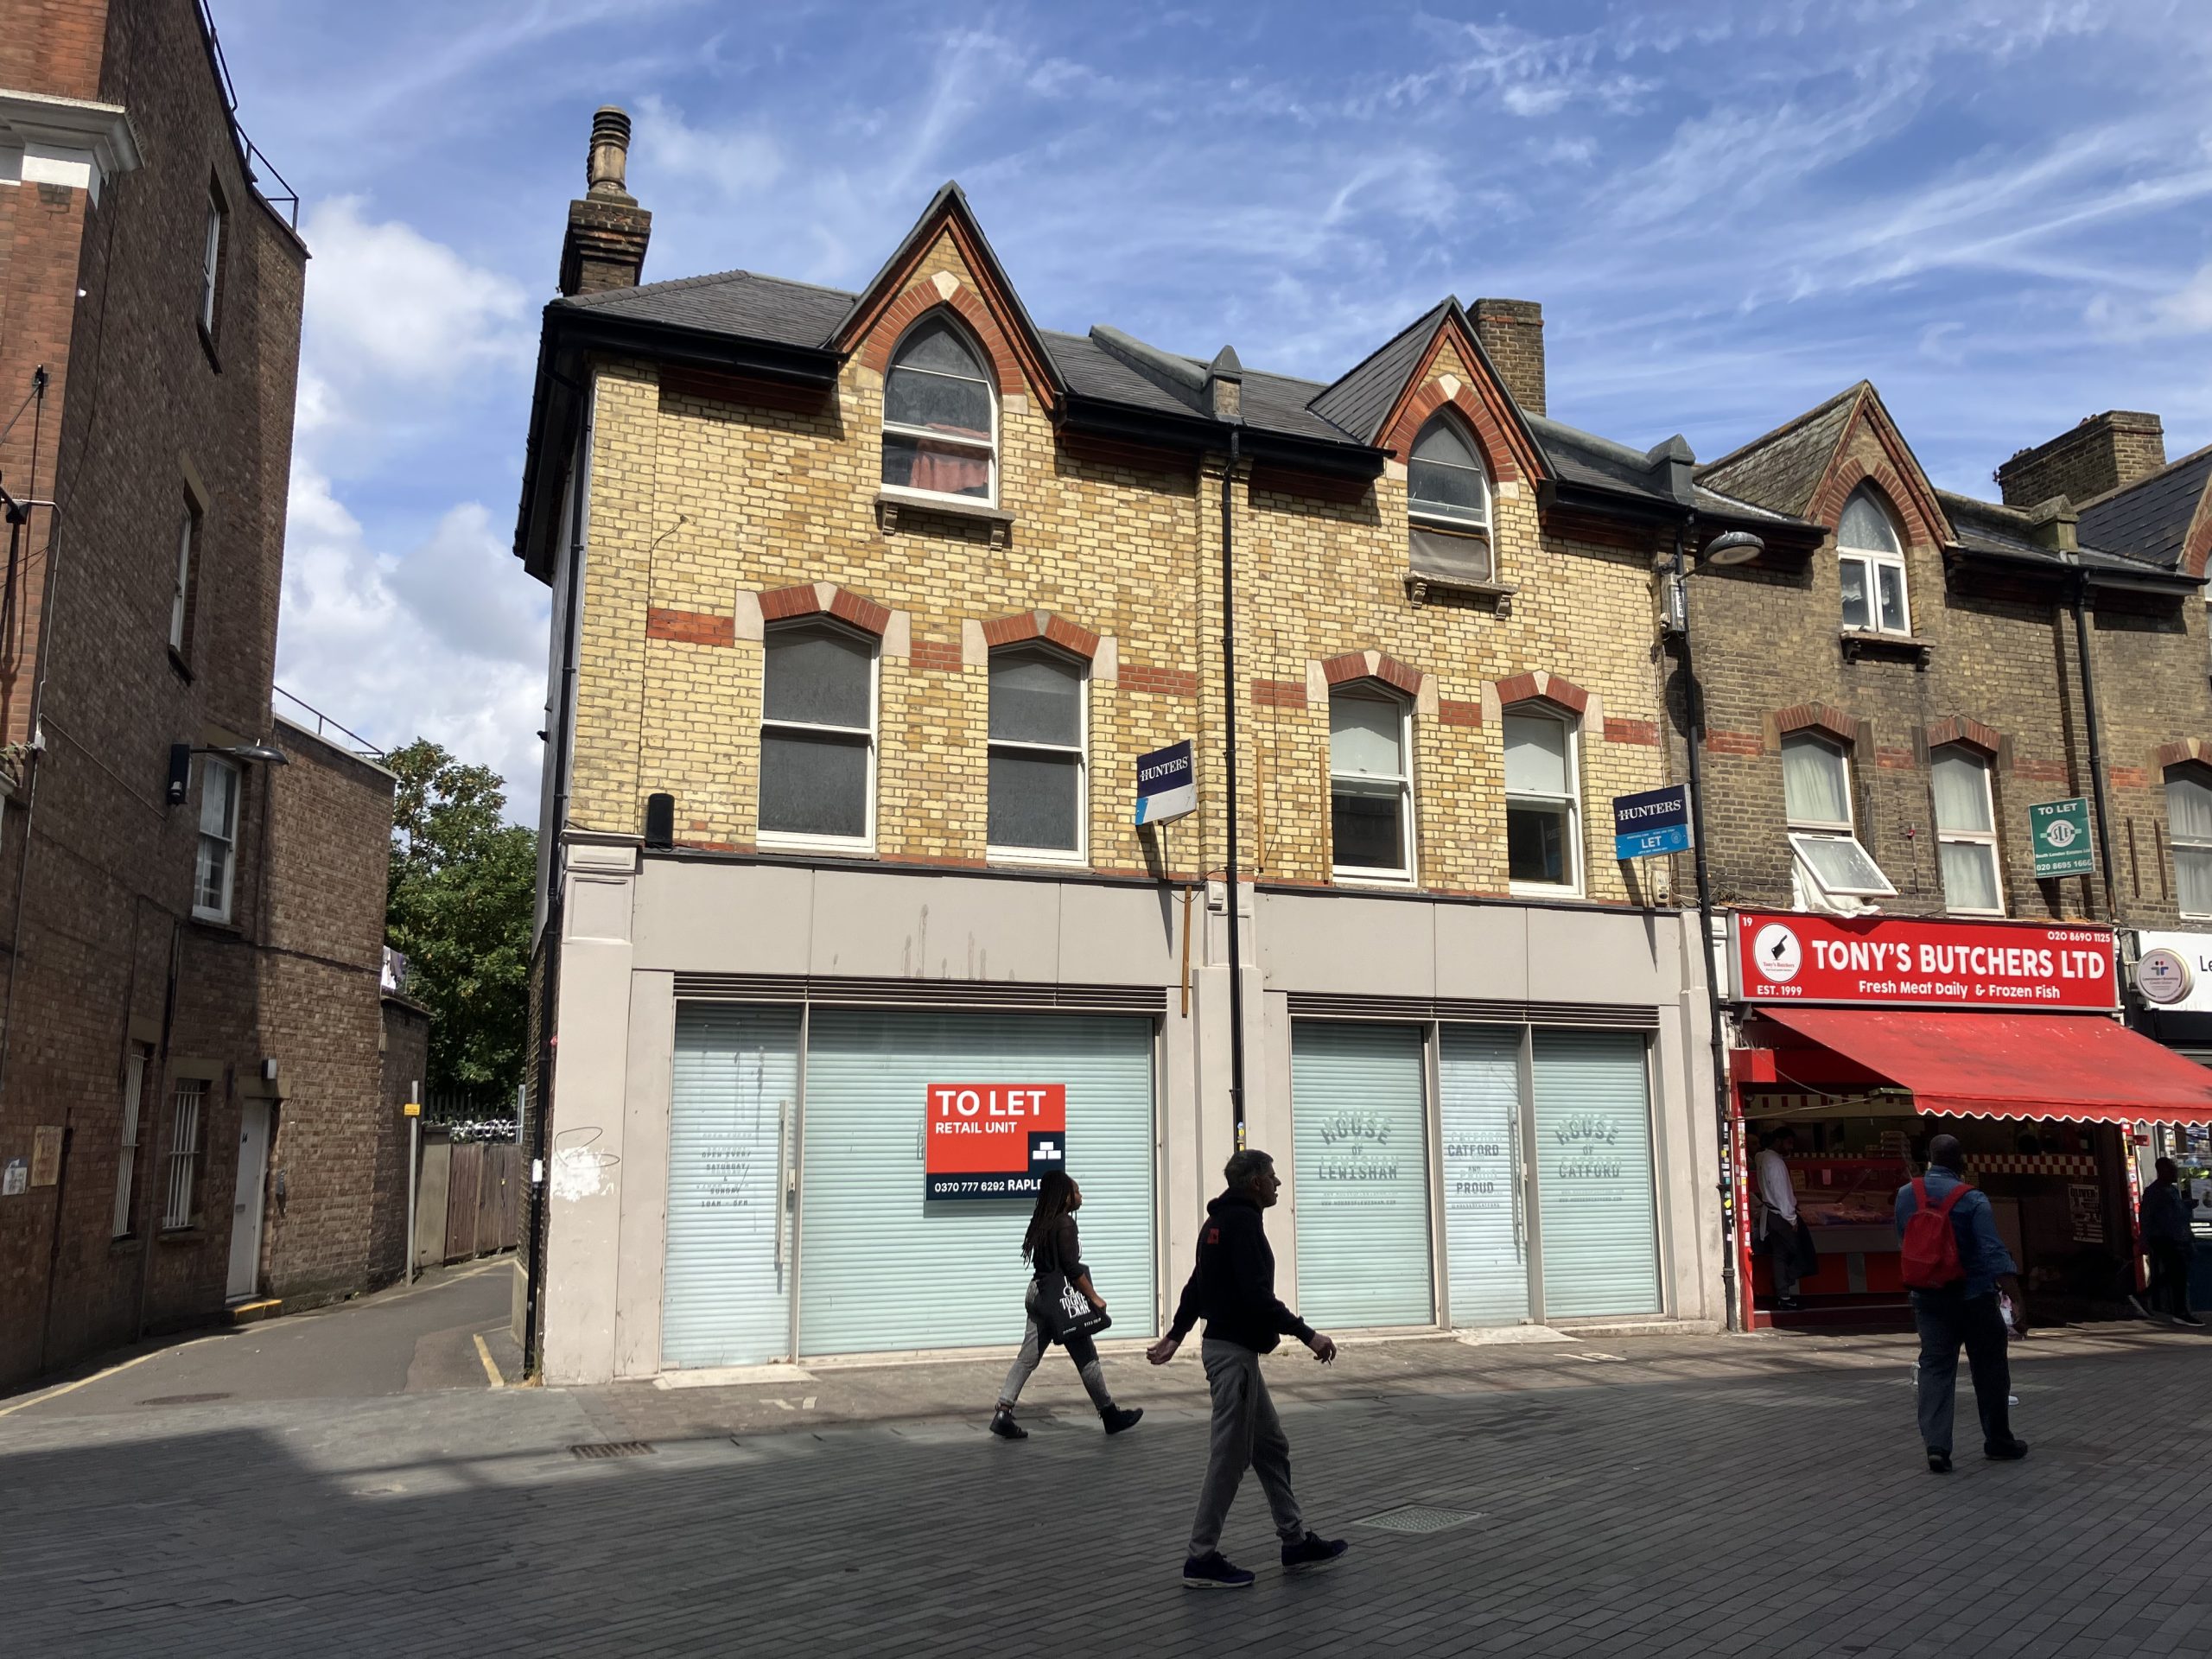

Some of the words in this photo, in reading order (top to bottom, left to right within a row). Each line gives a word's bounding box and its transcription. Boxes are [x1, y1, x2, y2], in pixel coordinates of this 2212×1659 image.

[1140, 756, 1188, 782] HUNTERS
[1618, 799, 1681, 821] HUNTERS
[2037, 806, 2054, 816] TO
[2056, 803, 2078, 813] LET
[1642, 836, 1662, 849] LET
[2052, 861, 2072, 870] 8695
[1742, 917, 1753, 927] 19
[2048, 931, 2068, 941] 020
[2069, 931, 2092, 942] 8690
[2094, 932, 2111, 943] 1125
[1811, 939, 1912, 973] TONY'S
[1919, 944, 2054, 978] BUTCHERS
[2061, 950, 2106, 979] LTD
[1757, 985, 1779, 995] EST.
[1781, 986, 1802, 996] 1999
[1859, 980, 1897, 994] Fresh
[1900, 981, 1932, 995] Meat
[1935, 982, 1968, 999] Daily
[1975, 983, 1986, 996] &
[1988, 984, 2032, 998] Frozen
[2035, 984, 2061, 999] Fish
[935, 1090, 980, 1116] TO
[989, 1090, 1046, 1116] LET
[935, 1122, 982, 1134] RETAIL
[985, 1122, 1018, 1134] UNIT
[1320, 1117, 1392, 1146] HOUSE
[1555, 1119, 1619, 1146] HOUSE
[1351, 1146, 1363, 1155] OF
[1447, 1144, 1499, 1157] CATFORD
[1582, 1146, 1594, 1155] OF
[1319, 1165, 1397, 1180] LEWISHAM
[1559, 1164, 1620, 1179] CATFORD
[934, 1182, 959, 1193] 0370
[961, 1181, 979, 1192] 777
[981, 1180, 1005, 1192] 6292
[1456, 1181, 1494, 1194] PROUD
